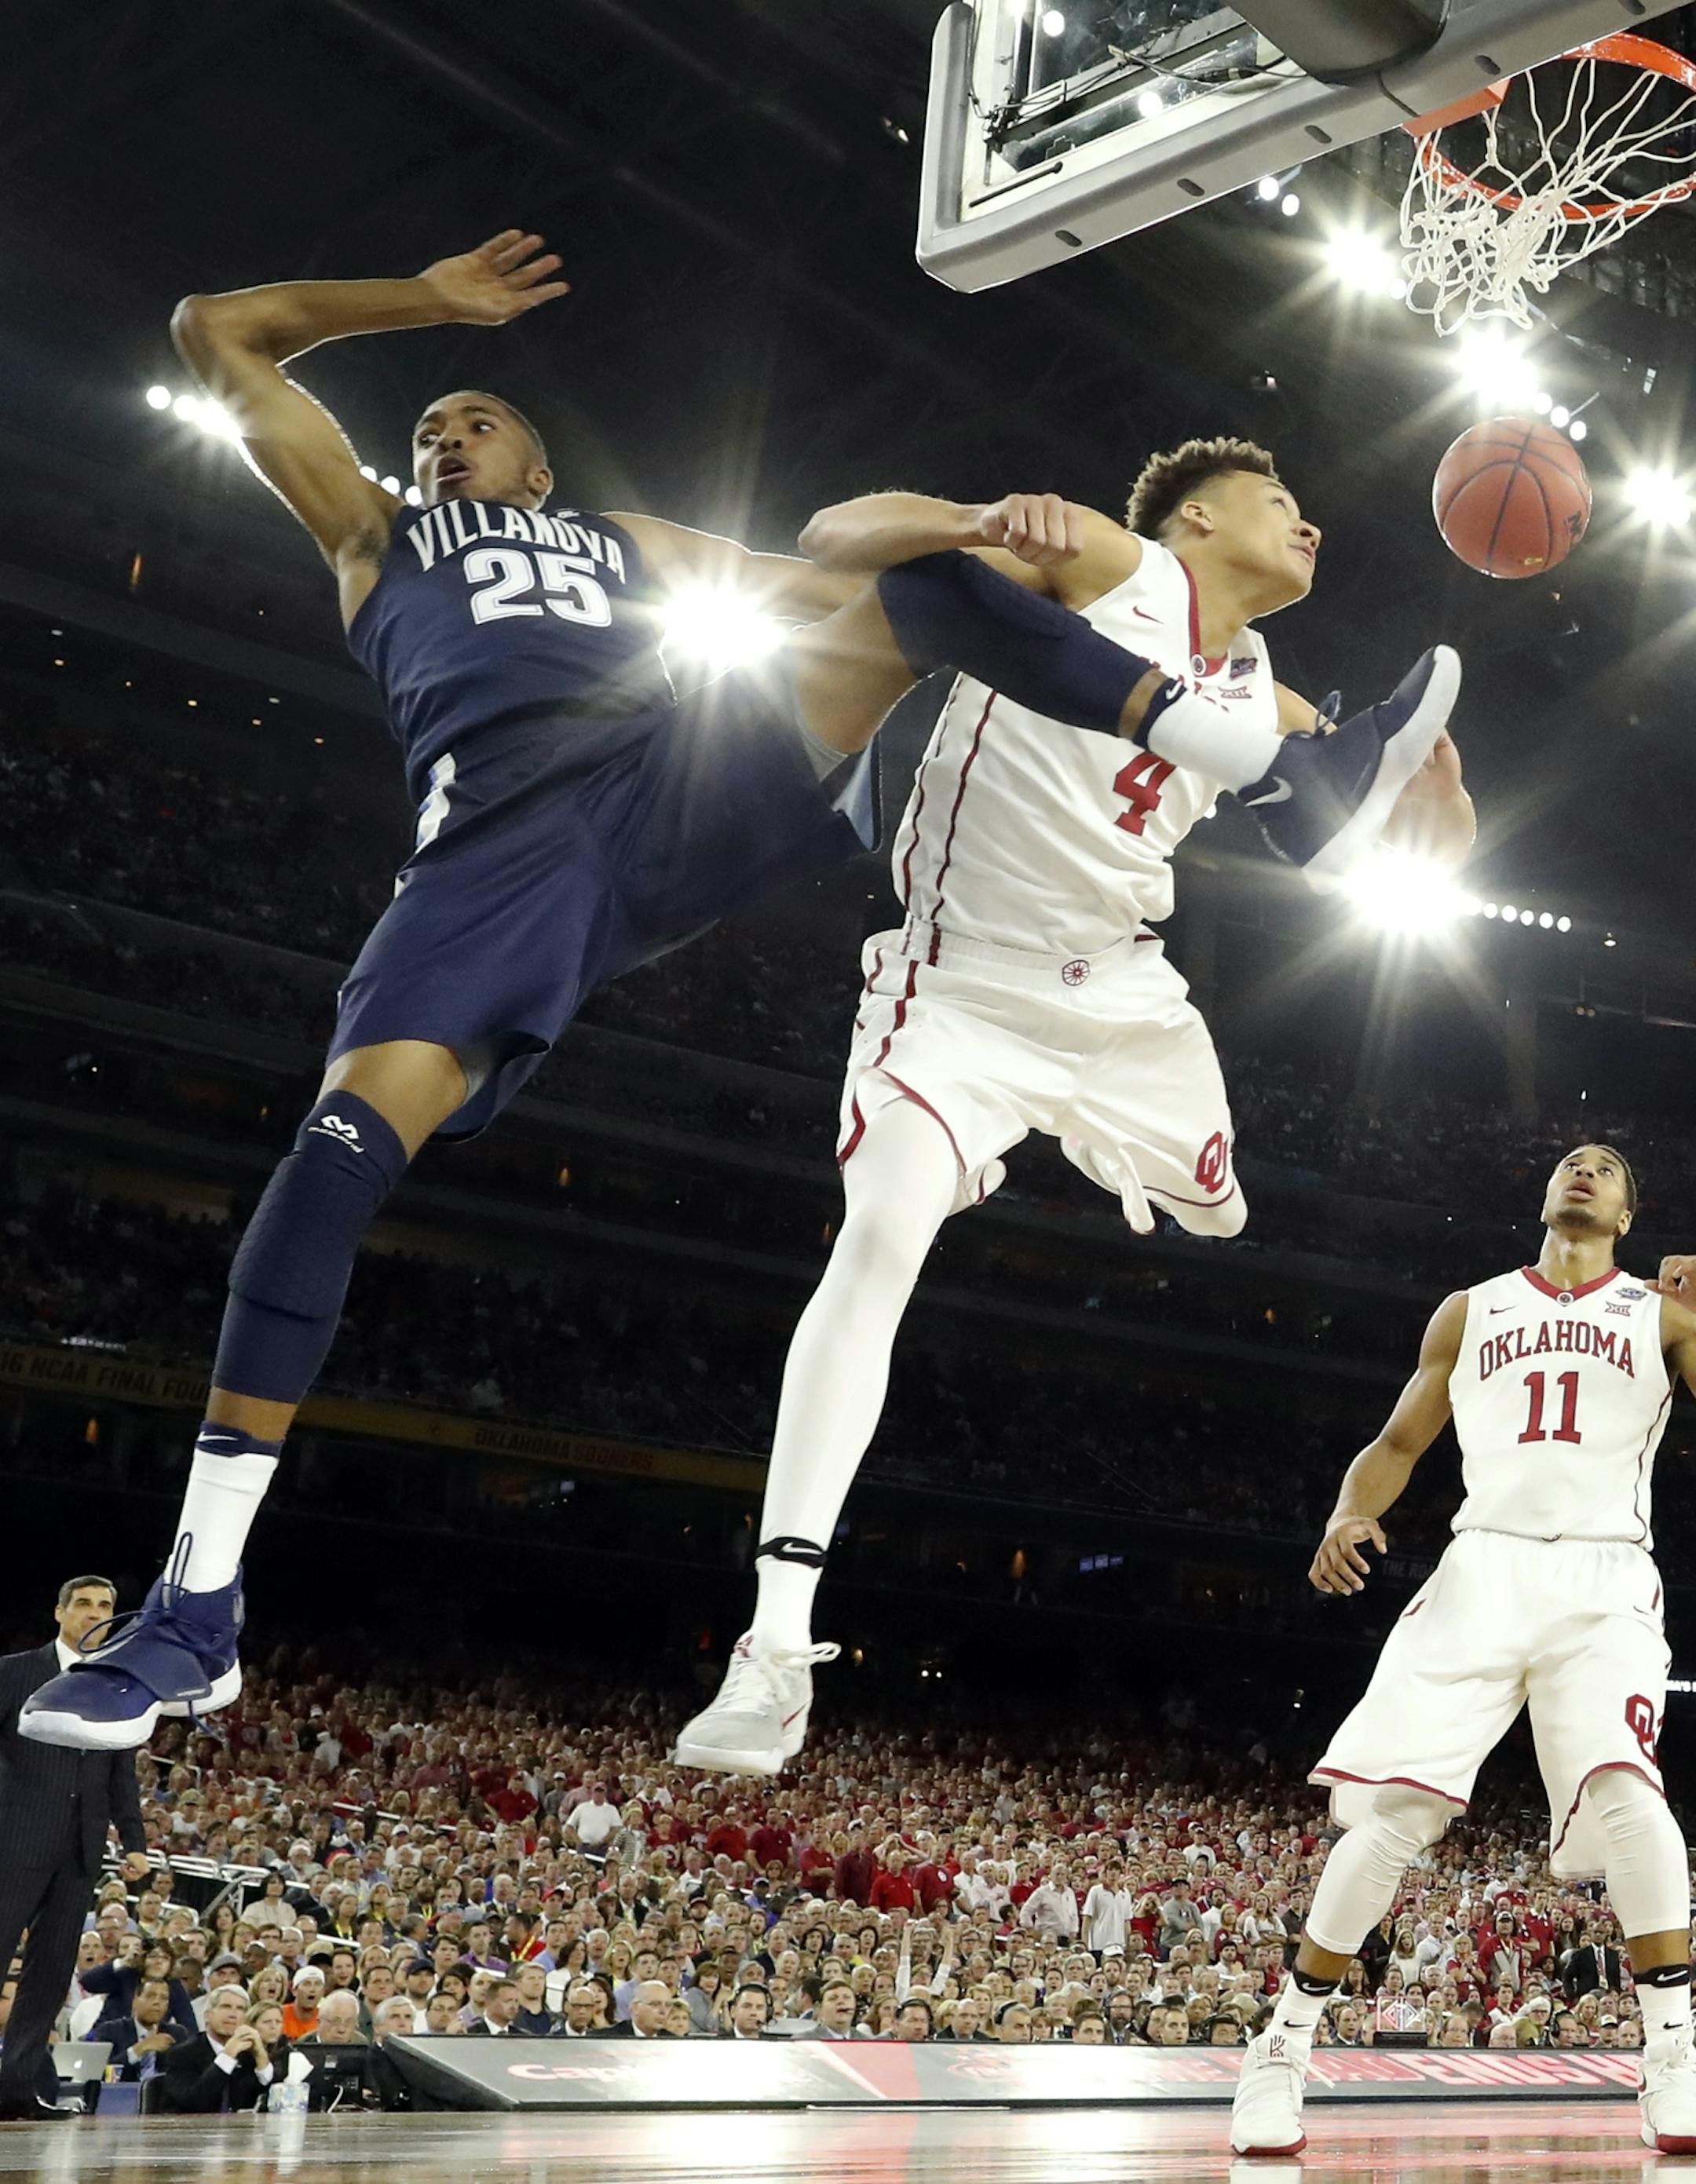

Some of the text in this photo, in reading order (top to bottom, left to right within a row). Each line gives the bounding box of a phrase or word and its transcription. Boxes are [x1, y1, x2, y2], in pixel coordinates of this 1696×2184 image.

[406, 499, 626, 584] VILLANOVA
[463, 547, 612, 627] 25
[1113, 751, 1177, 836] 4
[30, 1353, 88, 1385] NCAA
[97, 1366, 157, 1395] FINAL
[162, 1377, 210, 1402] FOU
[1479, 1320, 1635, 1382] OKLAHOMA
[1518, 1371, 1581, 1444] 11
[475, 1427, 571, 1459] OKLAHOMA
[1386, 2053, 1606, 2086] ENDS
